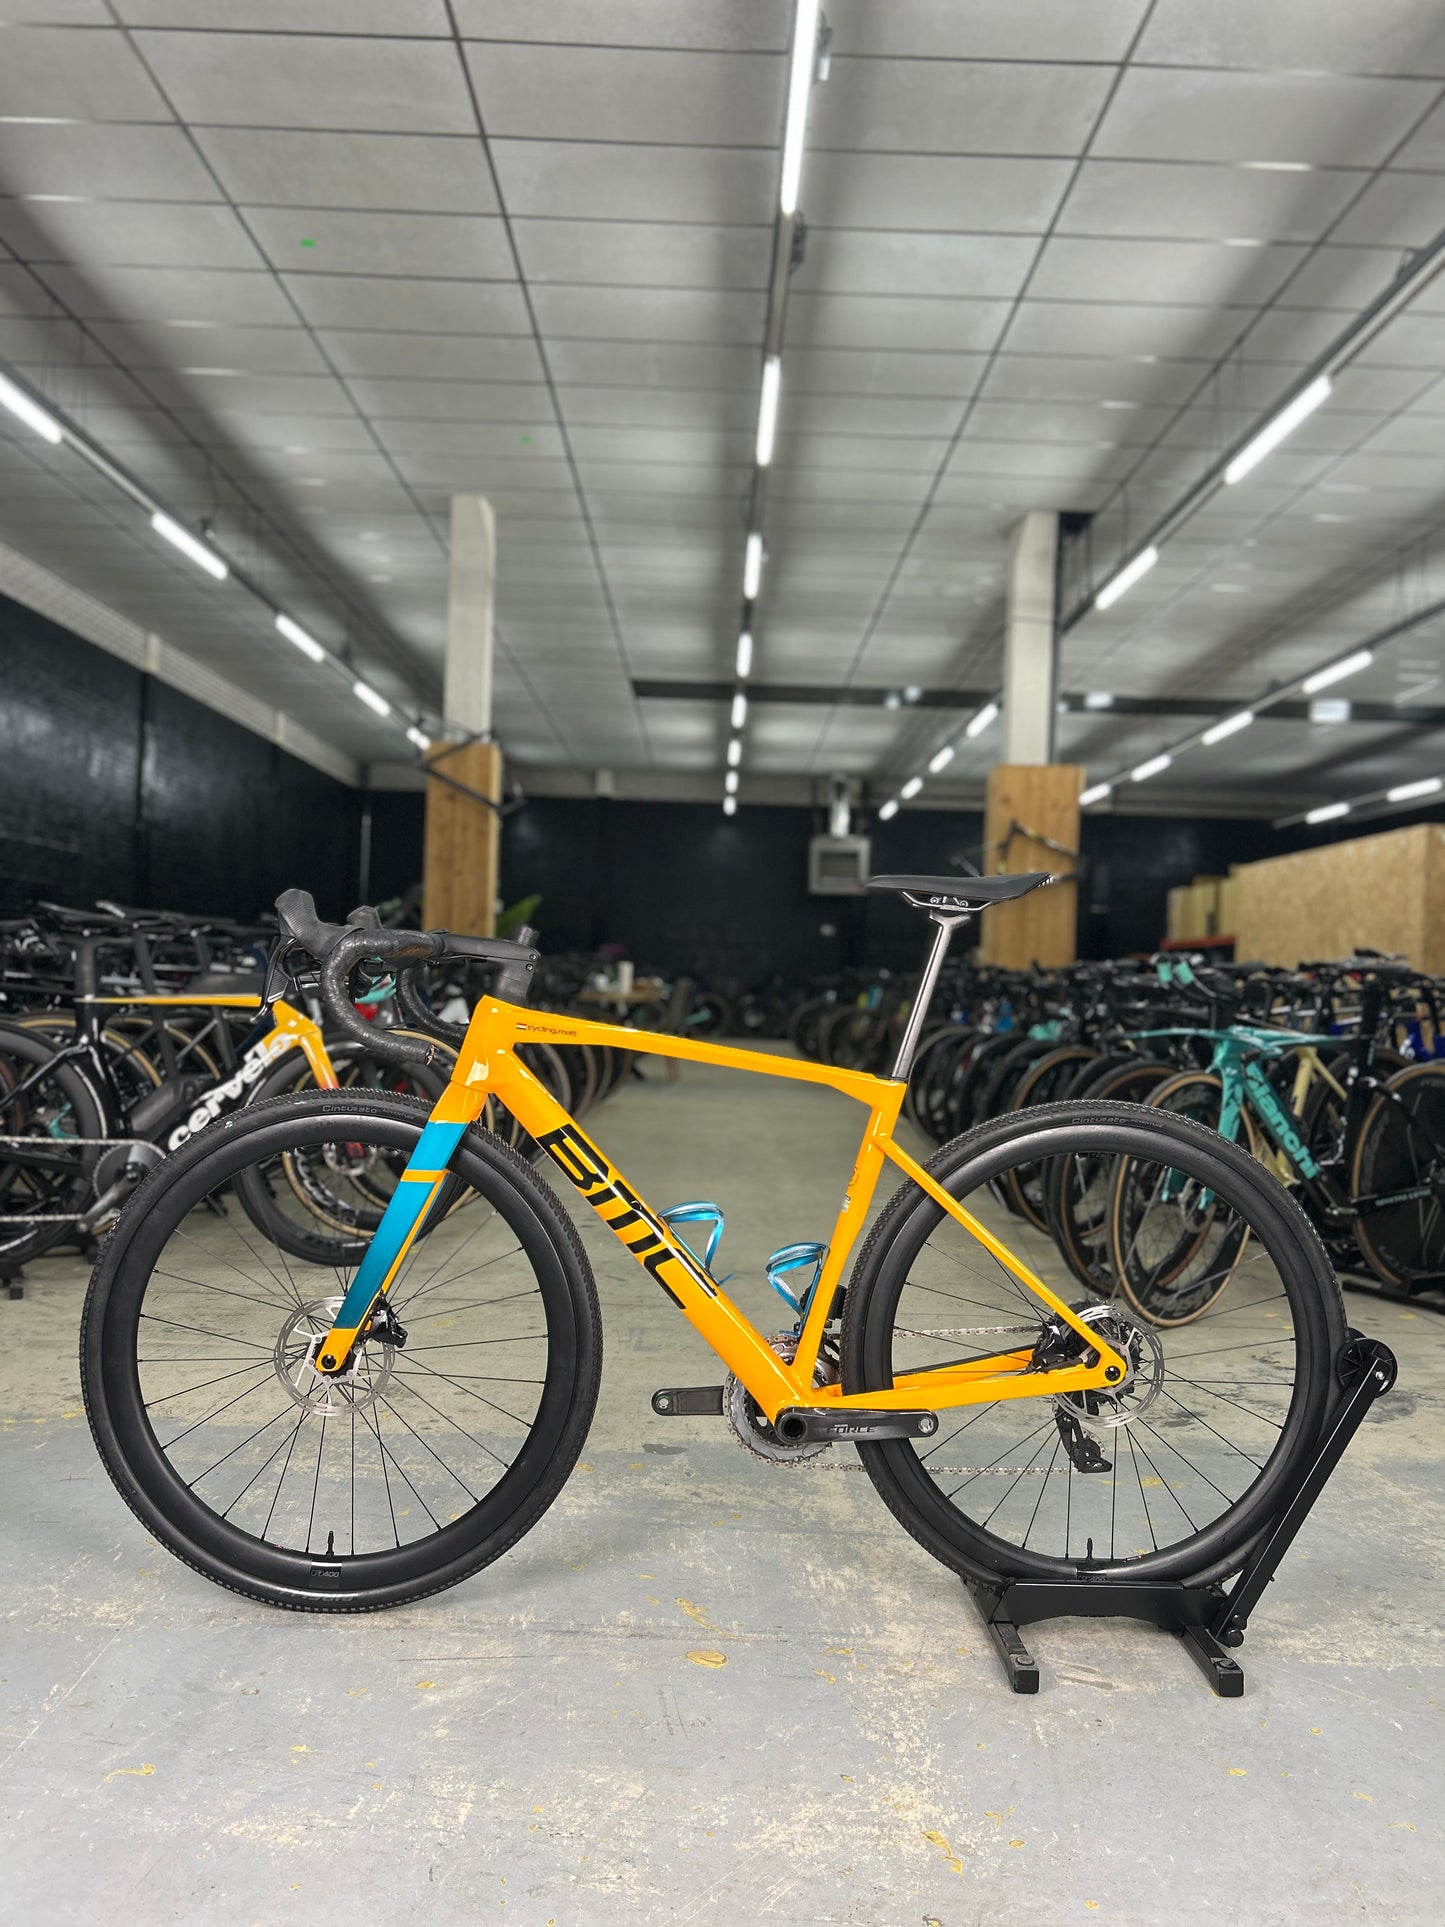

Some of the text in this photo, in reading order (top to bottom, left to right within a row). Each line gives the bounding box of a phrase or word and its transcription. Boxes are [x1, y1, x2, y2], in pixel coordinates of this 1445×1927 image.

[322, 1104, 378, 1114] Cinturato
[1072, 1116, 1127, 1125] Cinturato
[535, 1123, 718, 1310] BMC
[827, 1425, 876, 1434] FORCE
